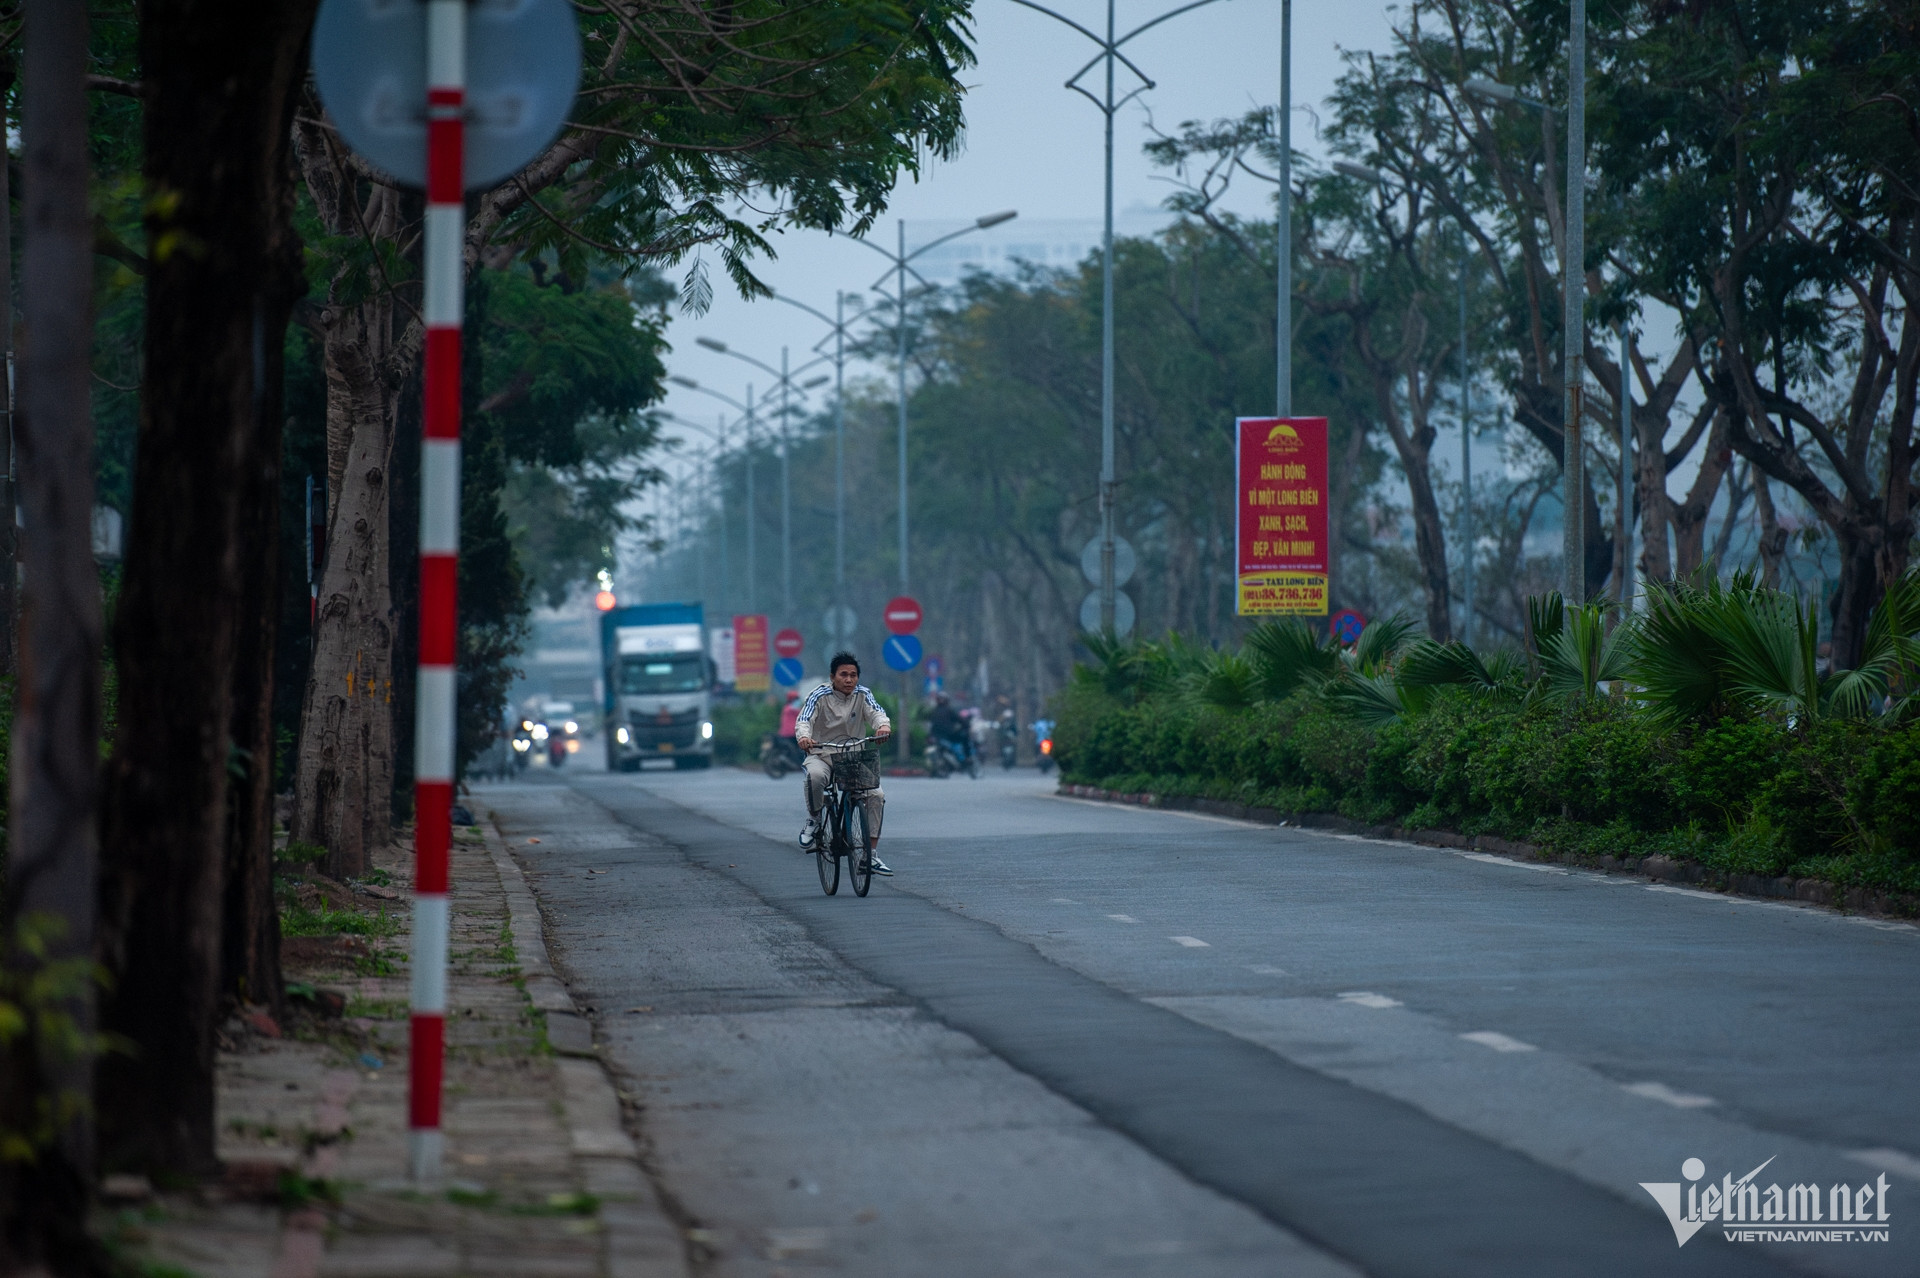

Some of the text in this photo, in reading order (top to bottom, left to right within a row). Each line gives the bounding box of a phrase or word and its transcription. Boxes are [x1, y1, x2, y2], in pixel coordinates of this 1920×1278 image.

[1260, 461, 1306, 483] HÀNH ĐỘNG
[1248, 487, 1319, 509] VÌ MỘT LONG BIÊN
[1259, 515, 1309, 534] XANH, SẠCH,
[1253, 538, 1315, 559] ĐẸP, VĂN MINH!
[1265, 578, 1284, 586] TAXI
[1286, 578, 1305, 586] LONG
[1307, 576, 1325, 586] BIÊN
